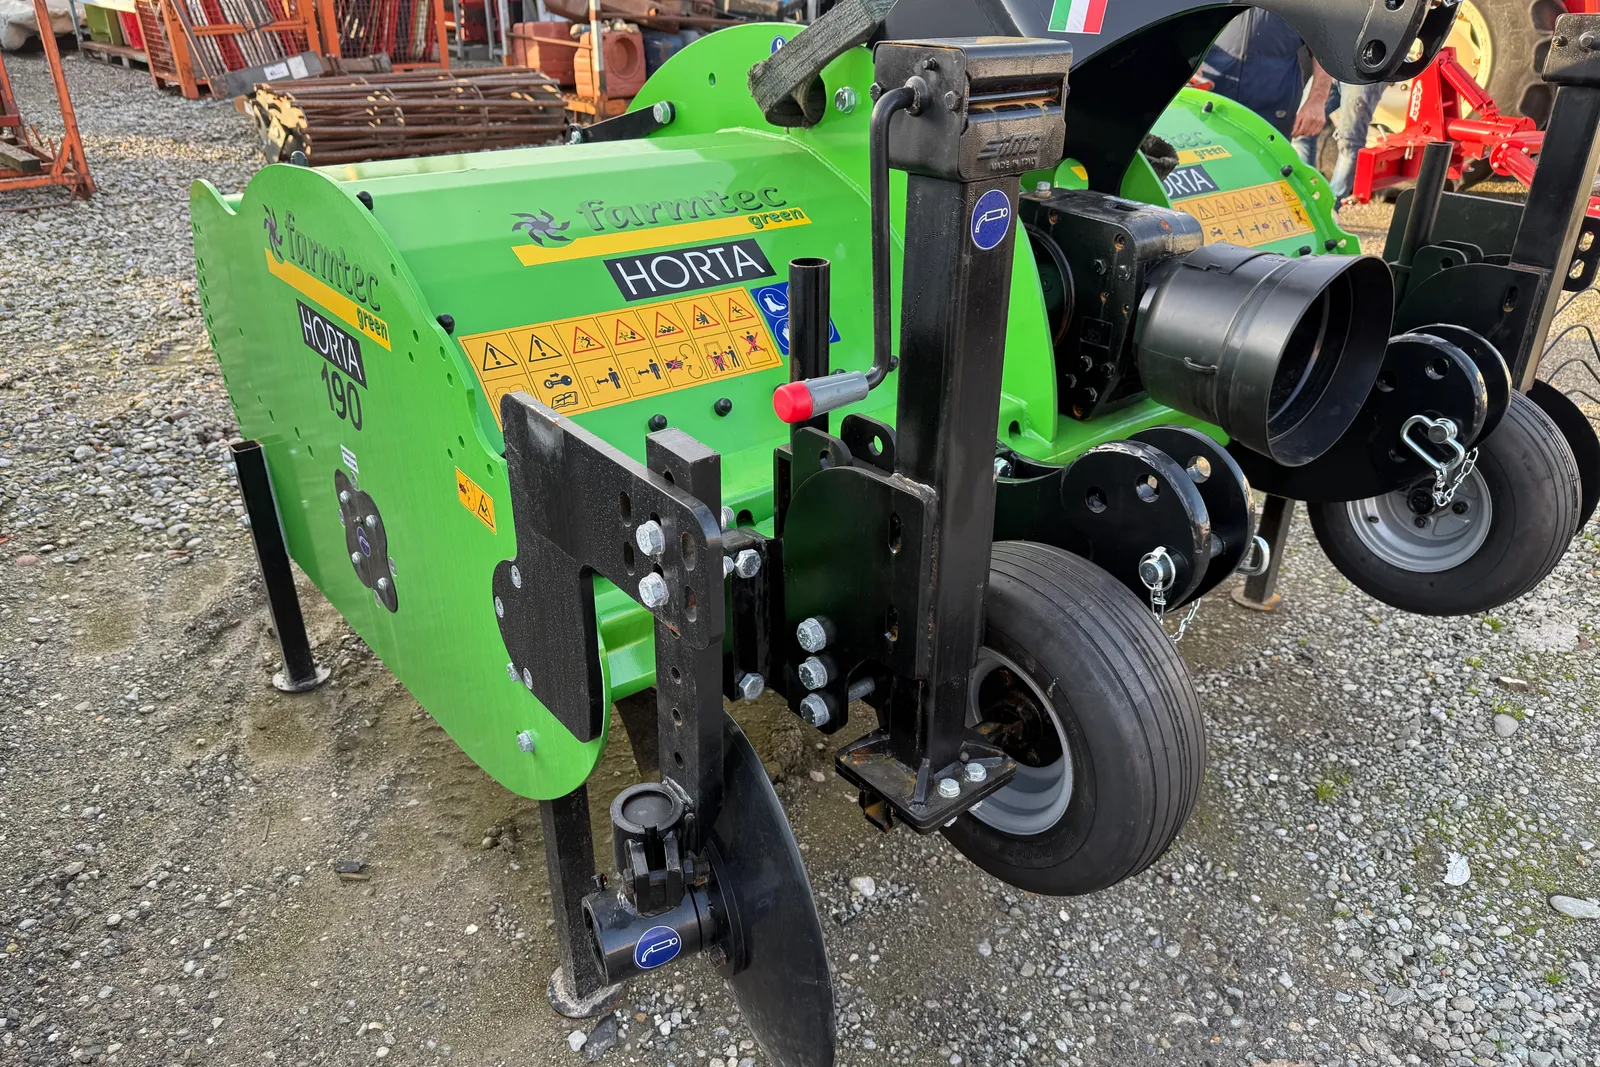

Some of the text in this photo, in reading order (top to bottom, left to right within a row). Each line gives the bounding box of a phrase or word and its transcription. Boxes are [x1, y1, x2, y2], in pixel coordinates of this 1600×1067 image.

[991, 160, 1010, 172] MADE
[1193, 146, 1226, 160] green
[576, 186, 787, 232] farmtec
[748, 208, 804, 230] green
[285, 210, 381, 312] farmtec
[616, 245, 766, 296] HORTA
[300, 305, 363, 381] HORTA
[357, 307, 389, 342] green
[321, 361, 362, 431] 190
